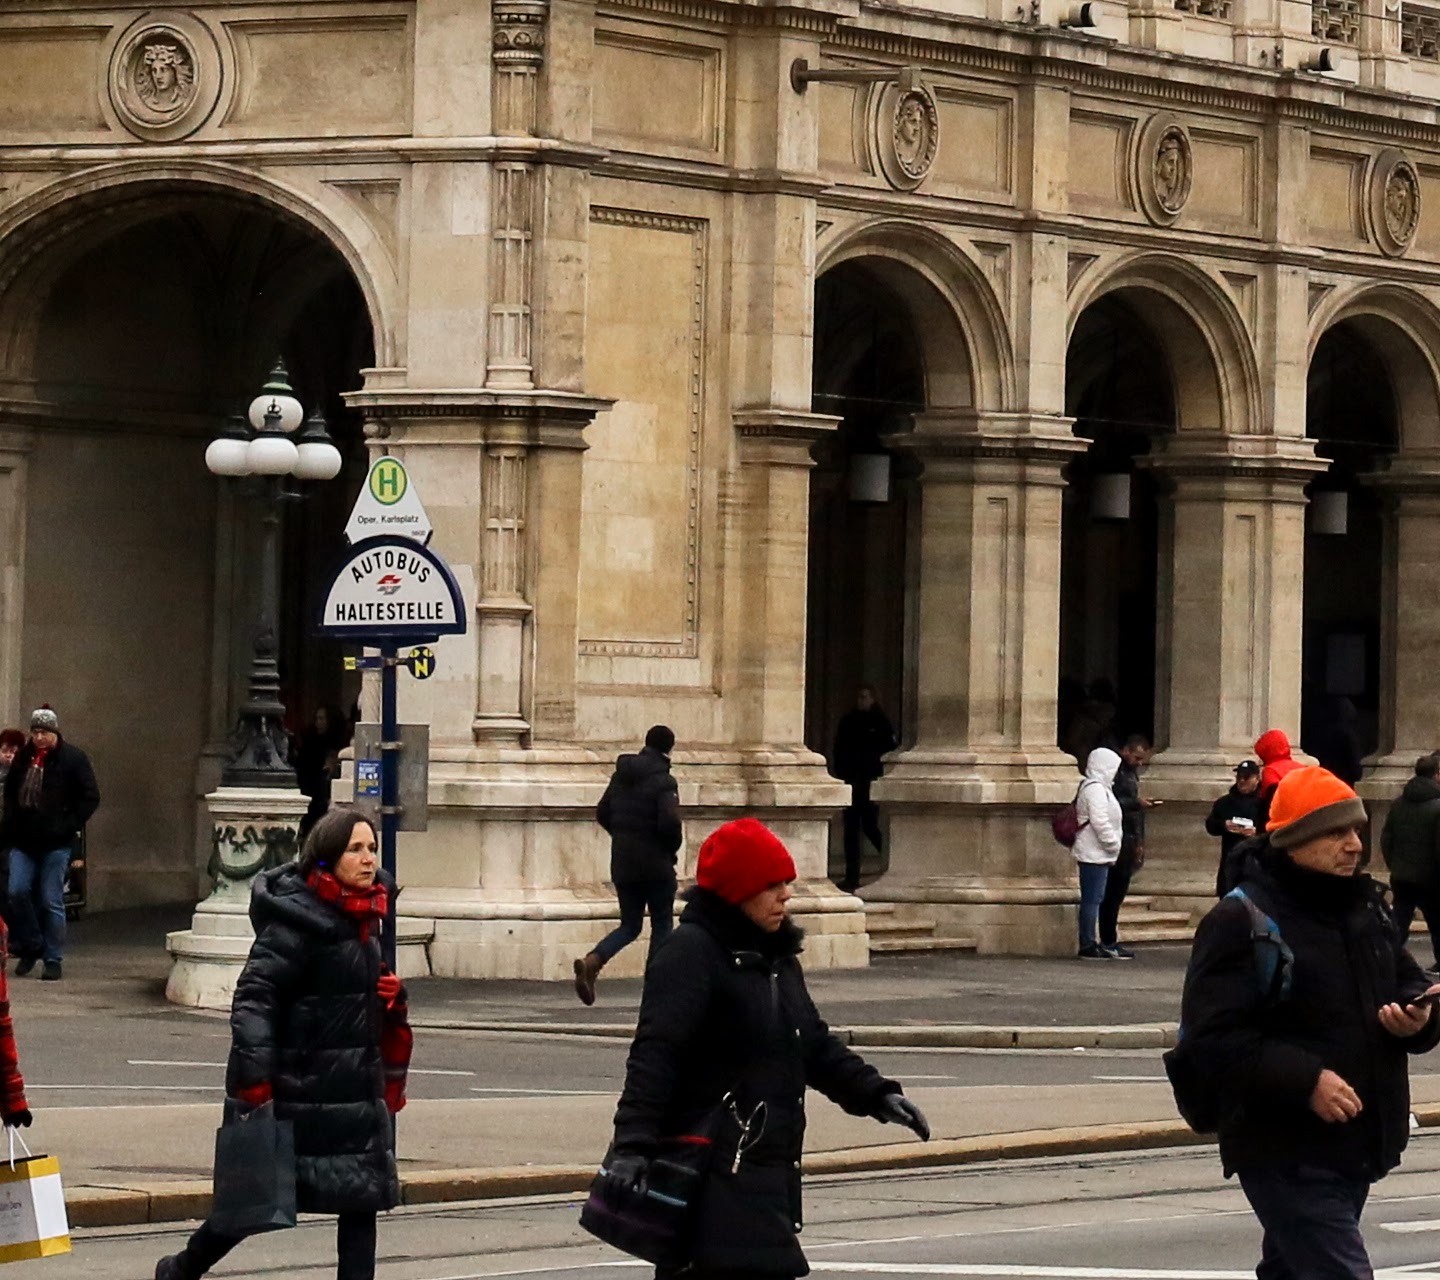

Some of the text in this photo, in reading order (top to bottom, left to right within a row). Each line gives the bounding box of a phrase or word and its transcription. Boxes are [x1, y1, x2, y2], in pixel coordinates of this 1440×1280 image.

[379, 467, 398, 496] H
[351, 550, 431, 584] AUTOBUS
[336, 601, 444, 621] HALTESTELLE
[414, 657, 429, 678] N
